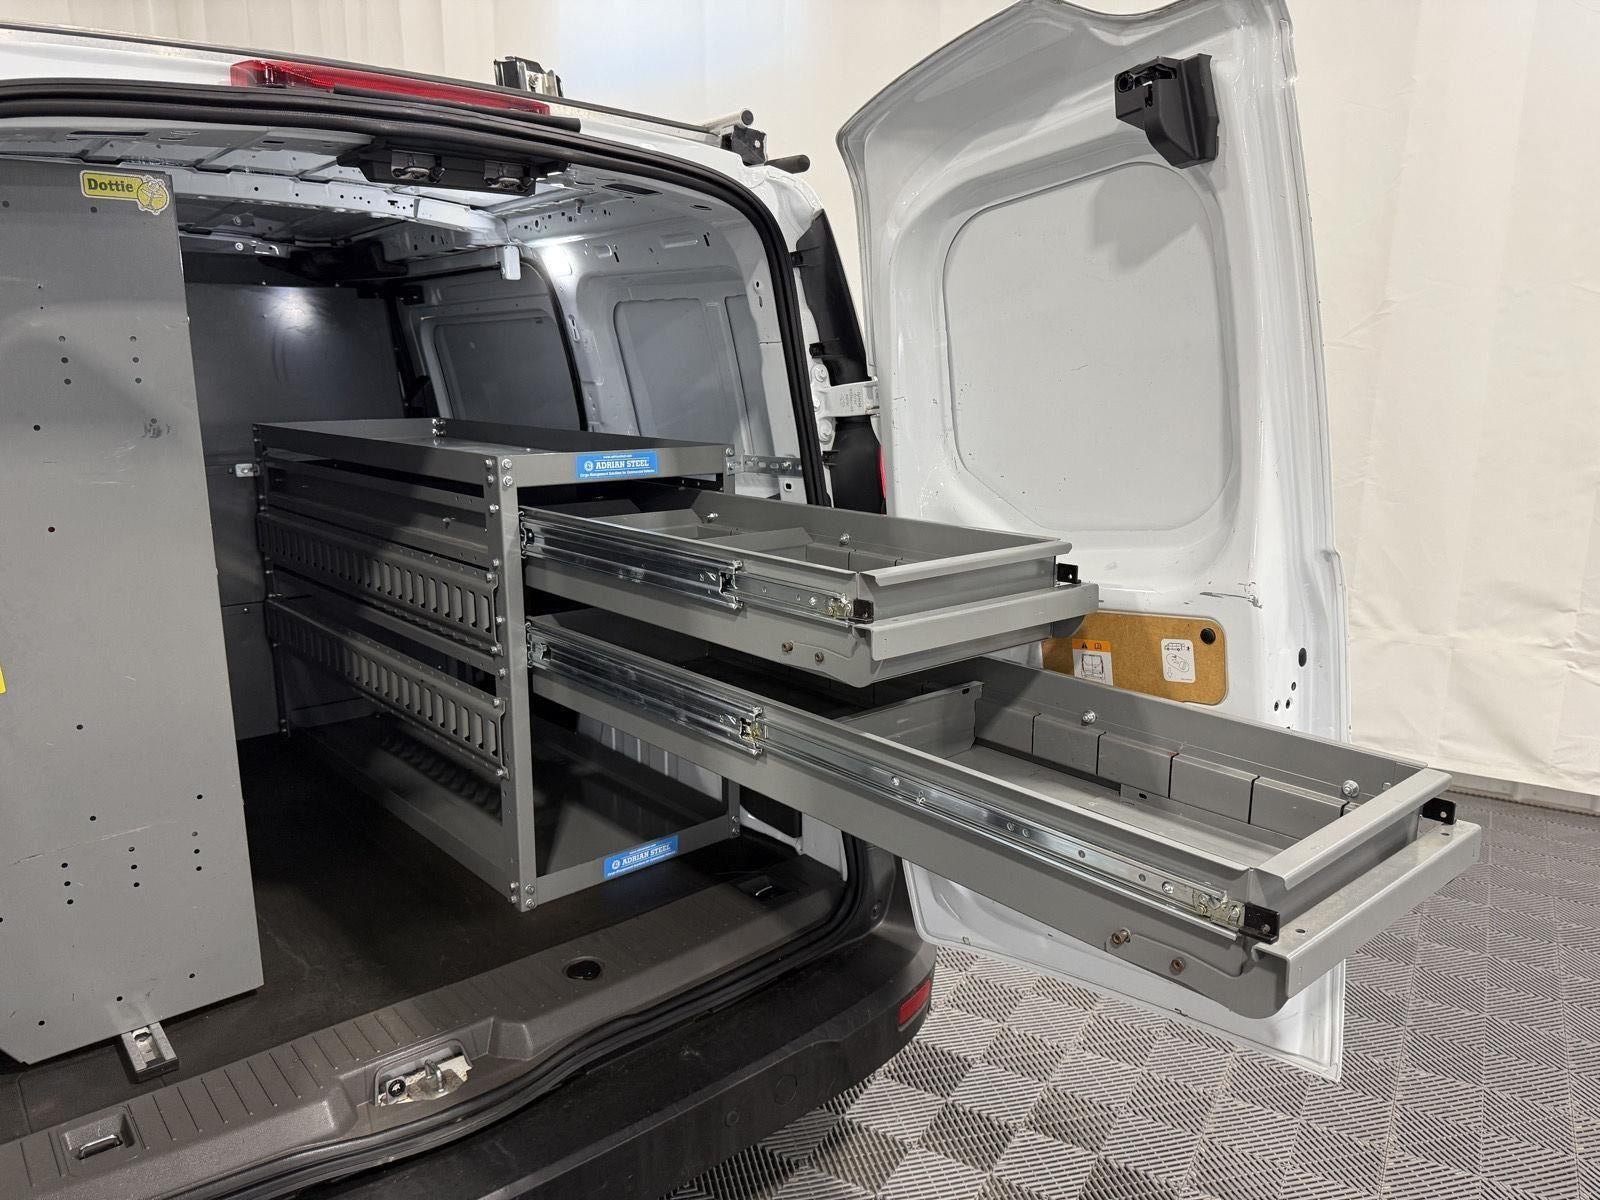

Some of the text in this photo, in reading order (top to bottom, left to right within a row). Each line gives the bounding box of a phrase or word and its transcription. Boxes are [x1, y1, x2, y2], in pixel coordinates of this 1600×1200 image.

[87, 178, 134, 193] Dottie
[595, 460, 650, 470] ADRIAN STEEL
[622, 851, 649, 866] ADRIAN
[650, 844, 671, 856] STEEL
